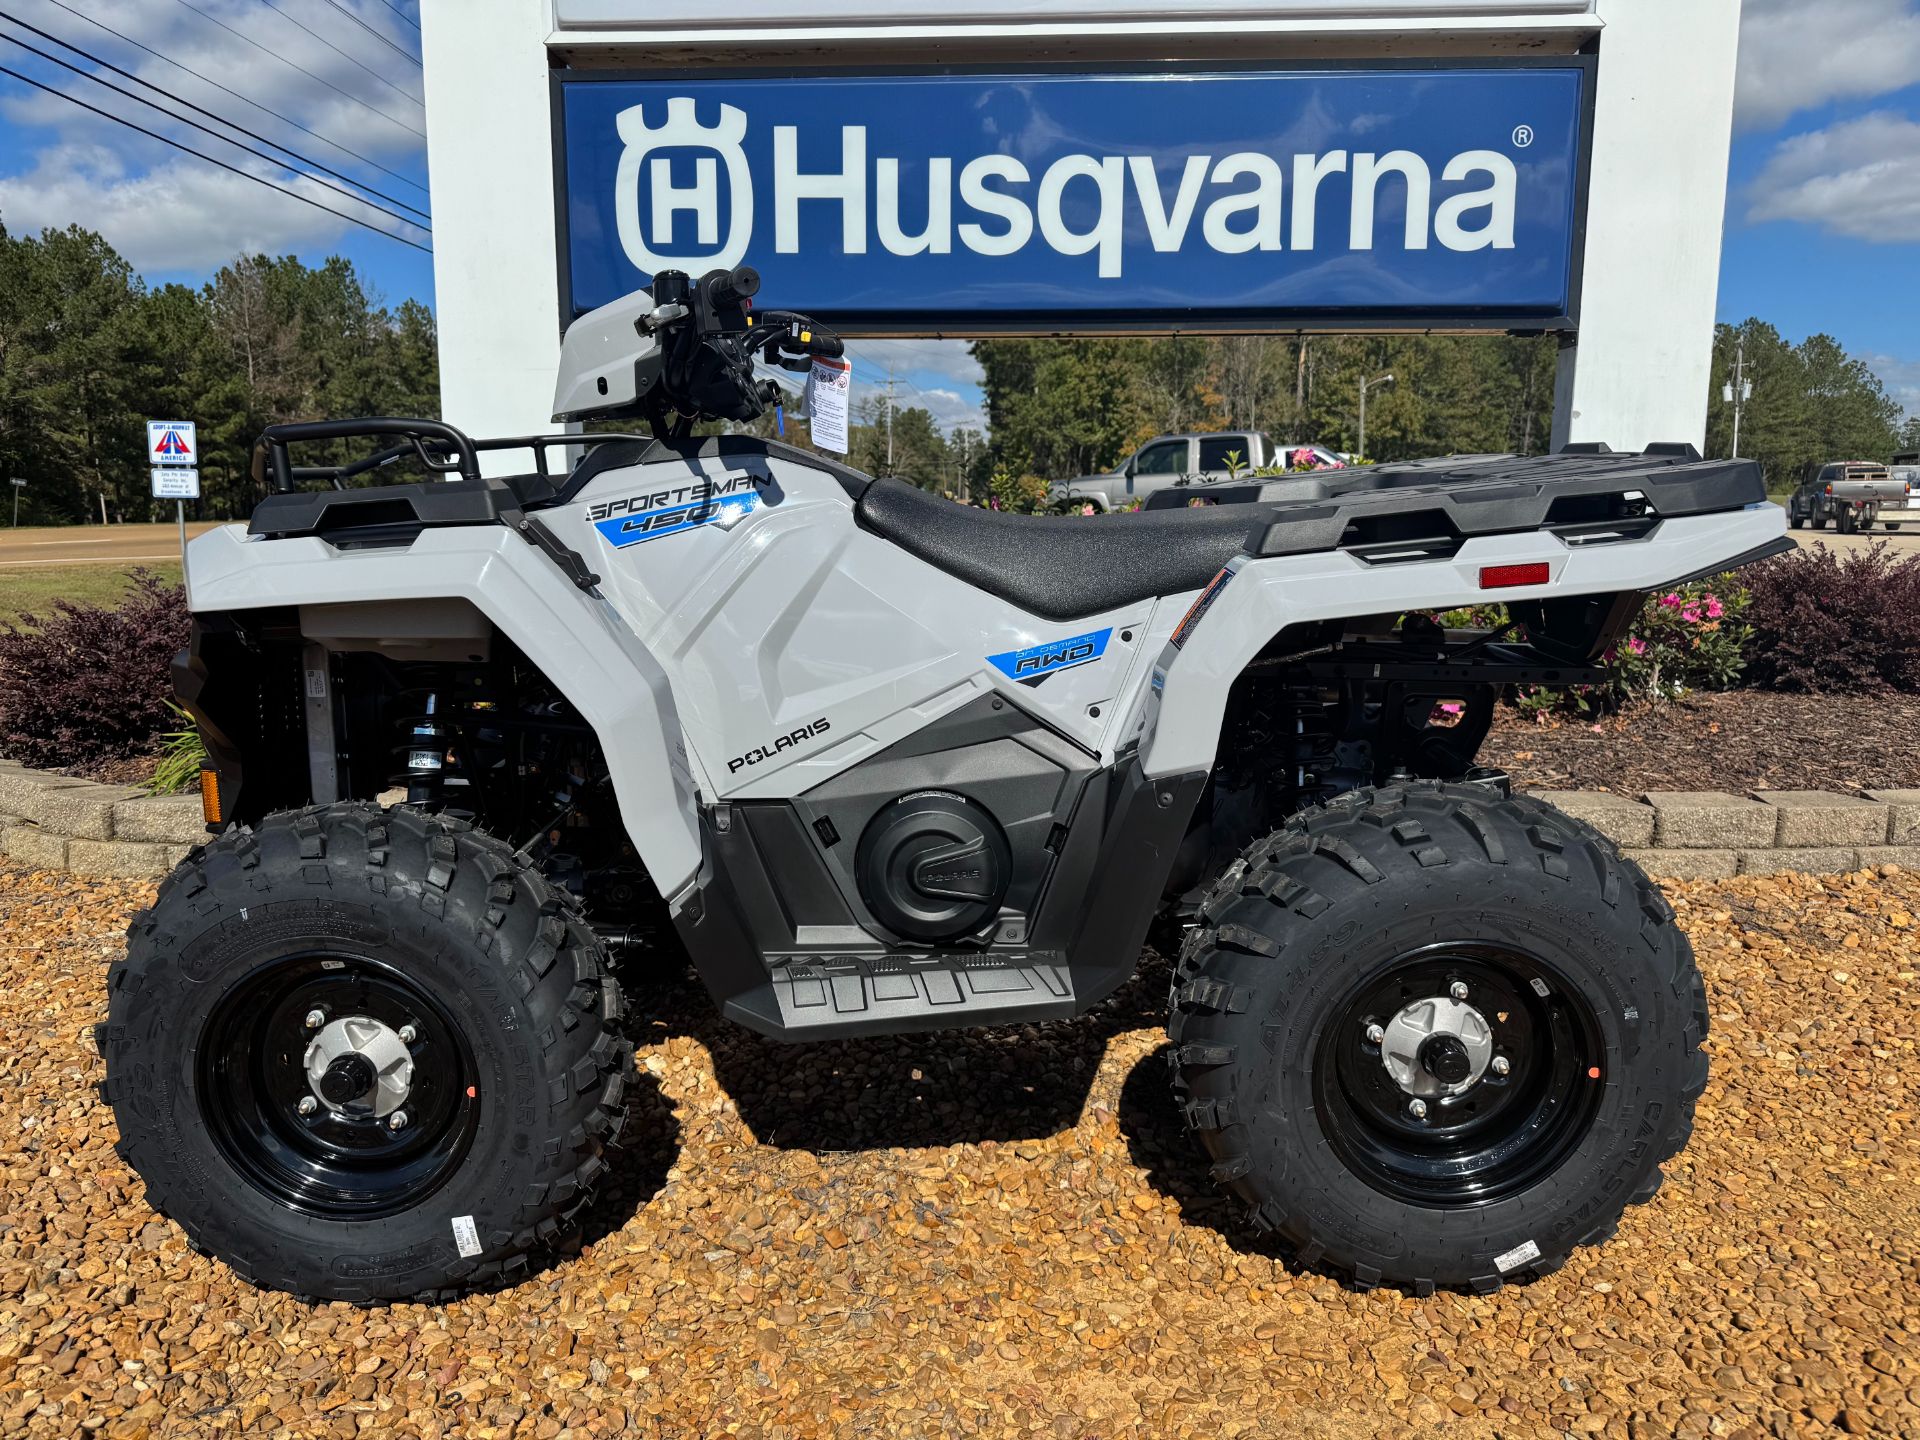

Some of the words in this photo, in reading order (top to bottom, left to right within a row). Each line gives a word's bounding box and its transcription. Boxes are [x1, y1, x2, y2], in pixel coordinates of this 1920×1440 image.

[773, 125, 1518, 279] Husqvarna
[585, 473, 772, 522] SPORTSMAN
[620, 501, 723, 534] 450
[1014, 642, 1095, 675] AWD
[1040, 635, 1096, 652] DEMAND
[727, 716, 831, 774] POLARIS
